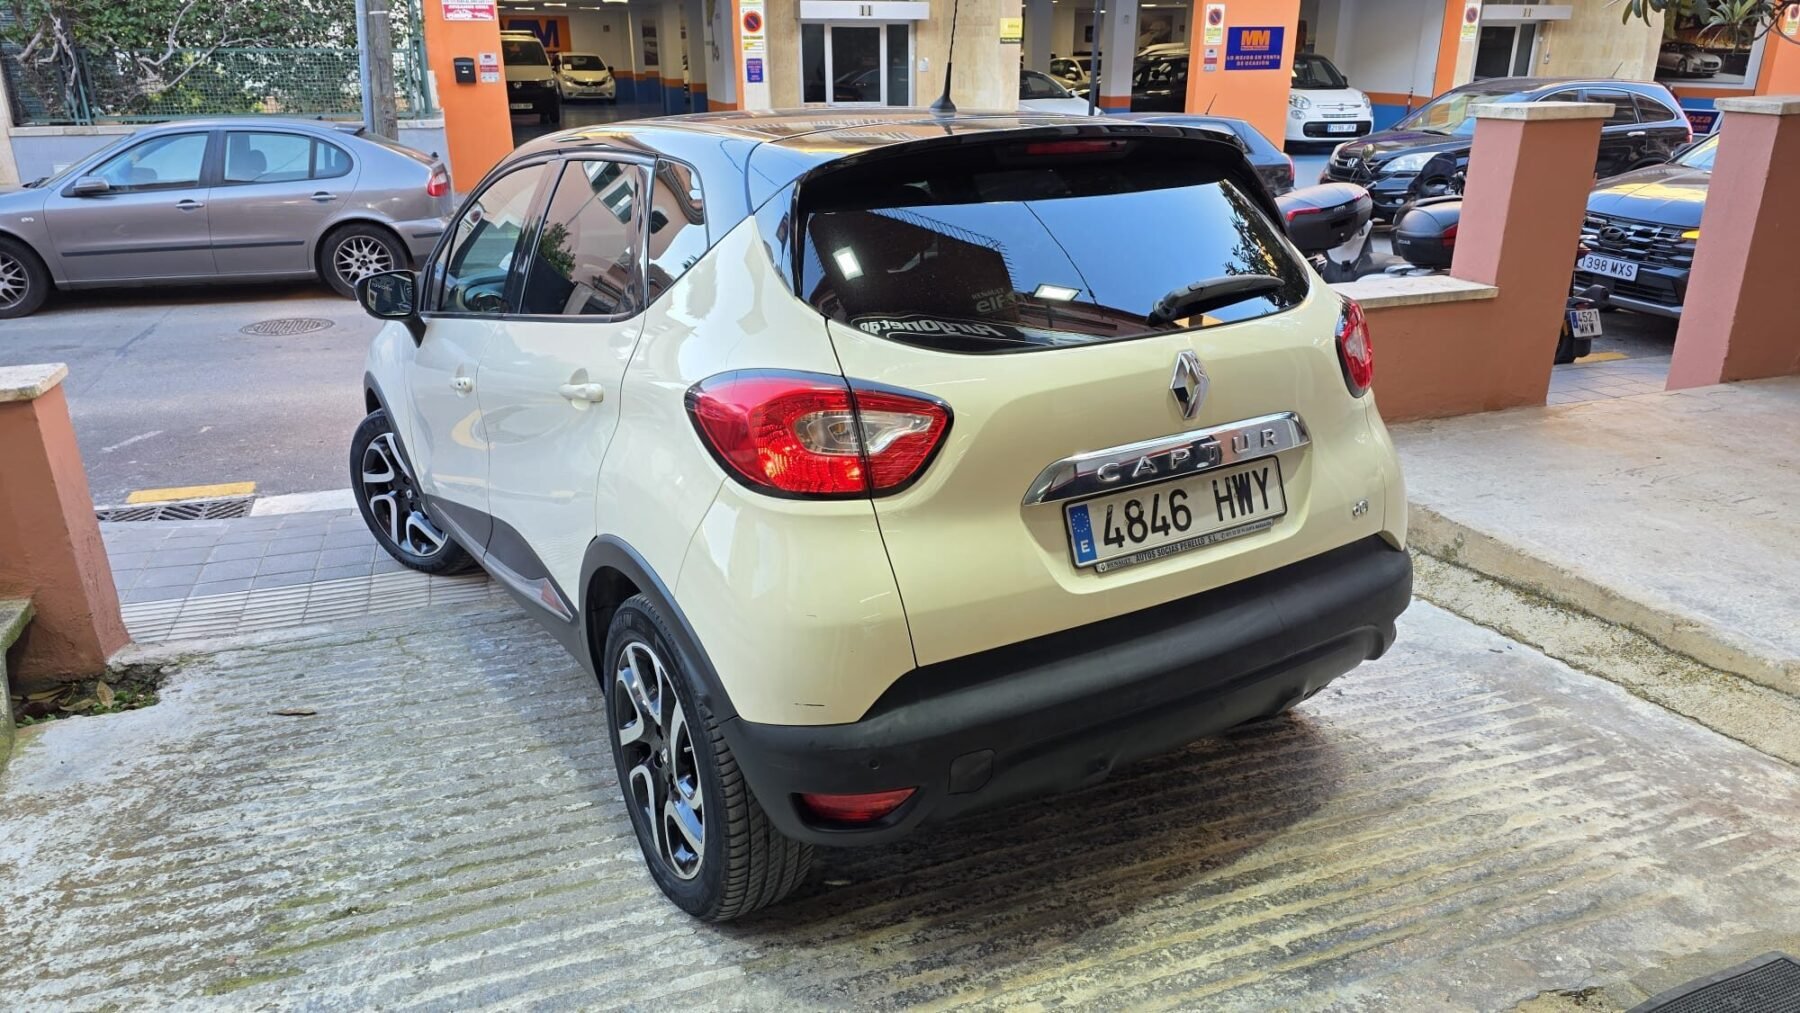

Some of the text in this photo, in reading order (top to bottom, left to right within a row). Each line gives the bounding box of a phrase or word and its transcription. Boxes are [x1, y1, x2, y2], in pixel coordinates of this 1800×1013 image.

[859, 5, 872, 16] 11
[1241, 30, 1271, 46] MM
[1582, 257, 1633, 277] 1398 MXS
[1578, 310, 1598, 323] 4521
[1097, 429, 1278, 482] CAPTUR
[1103, 467, 1270, 548] 4846 HWY
[1081, 541, 1091, 554] E
[1135, 550, 1156, 562] AUTOS
[1157, 545, 1180, 557] SOCIAS
[1180, 538, 1206, 551] PERELLO
